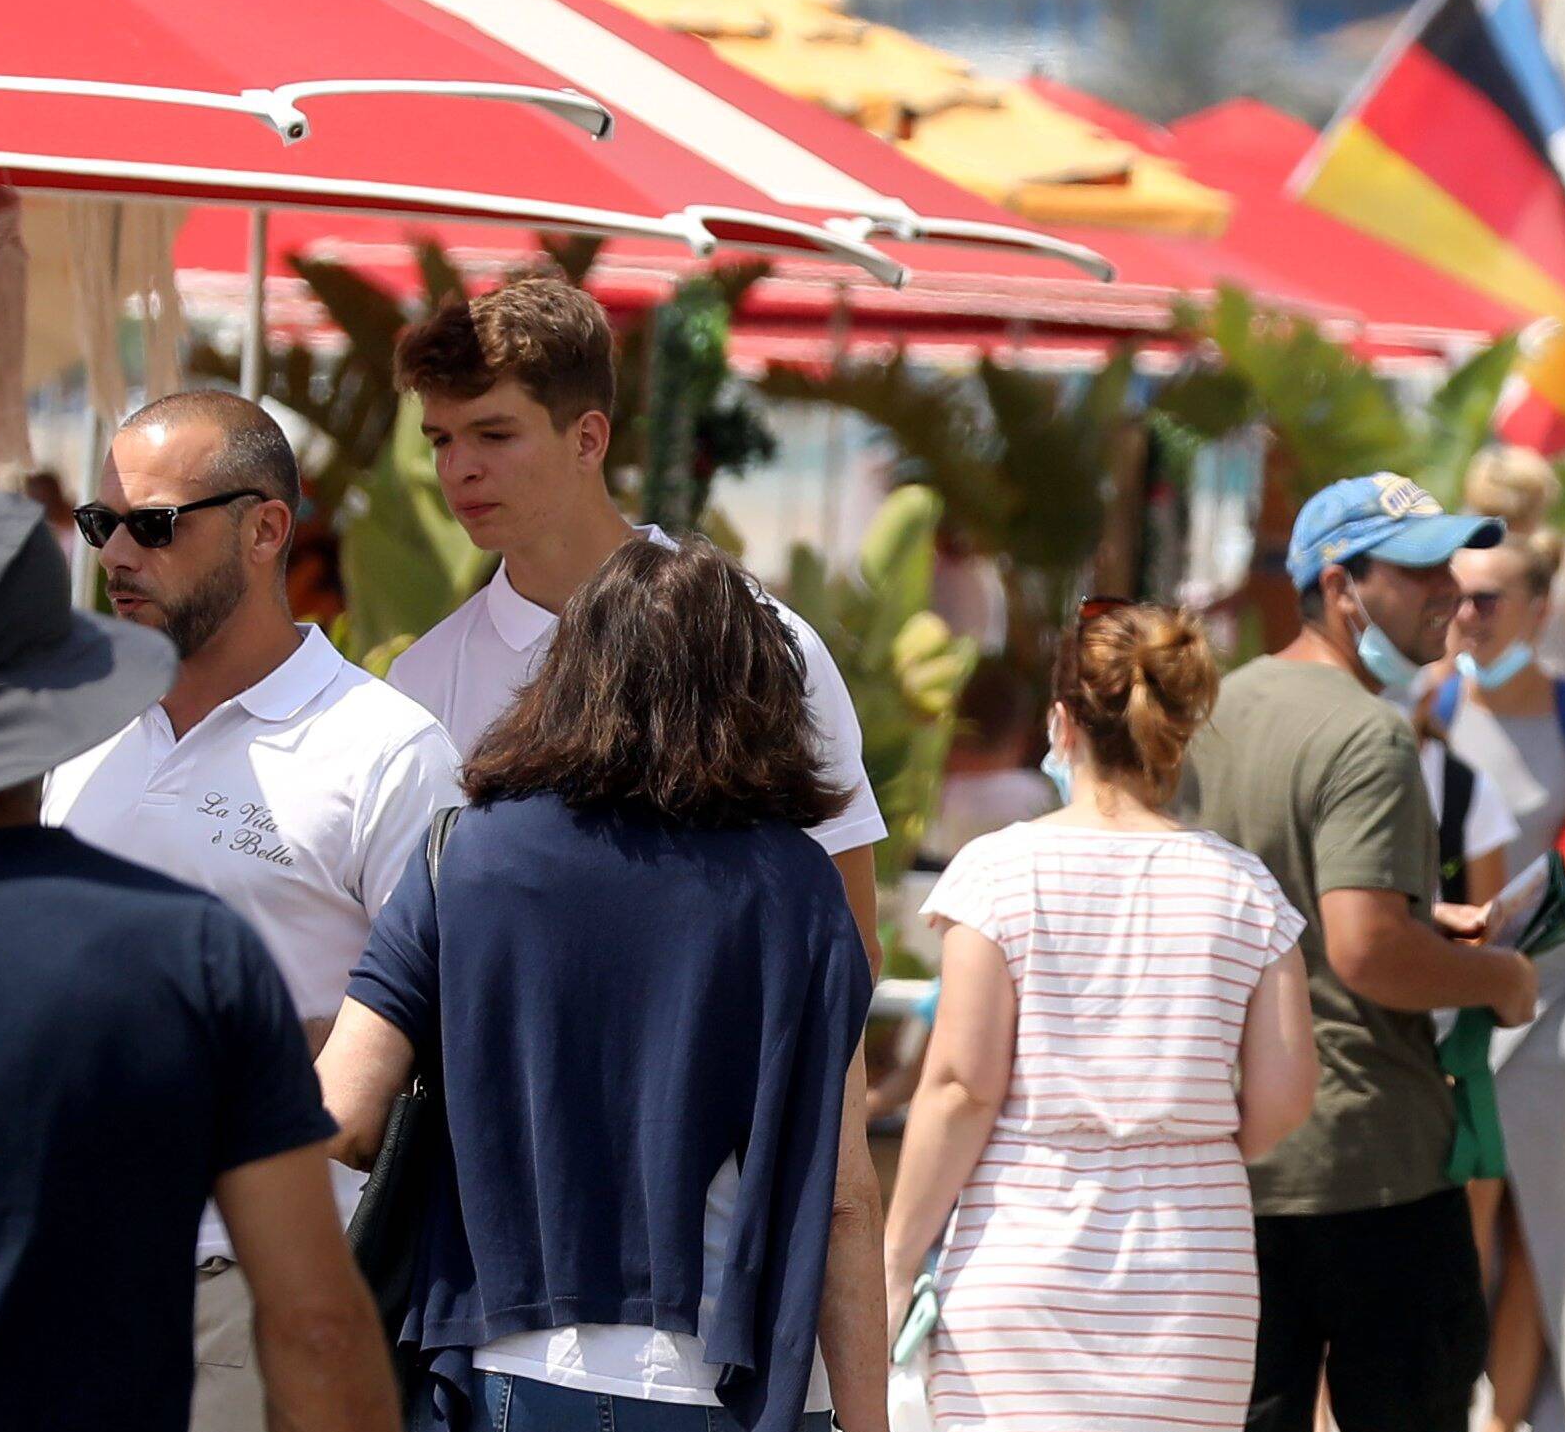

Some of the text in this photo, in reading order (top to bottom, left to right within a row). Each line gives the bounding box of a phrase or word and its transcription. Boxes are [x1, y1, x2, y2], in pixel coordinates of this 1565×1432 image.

[197, 792, 279, 834] La Vita
[229, 828, 295, 867] Bella
